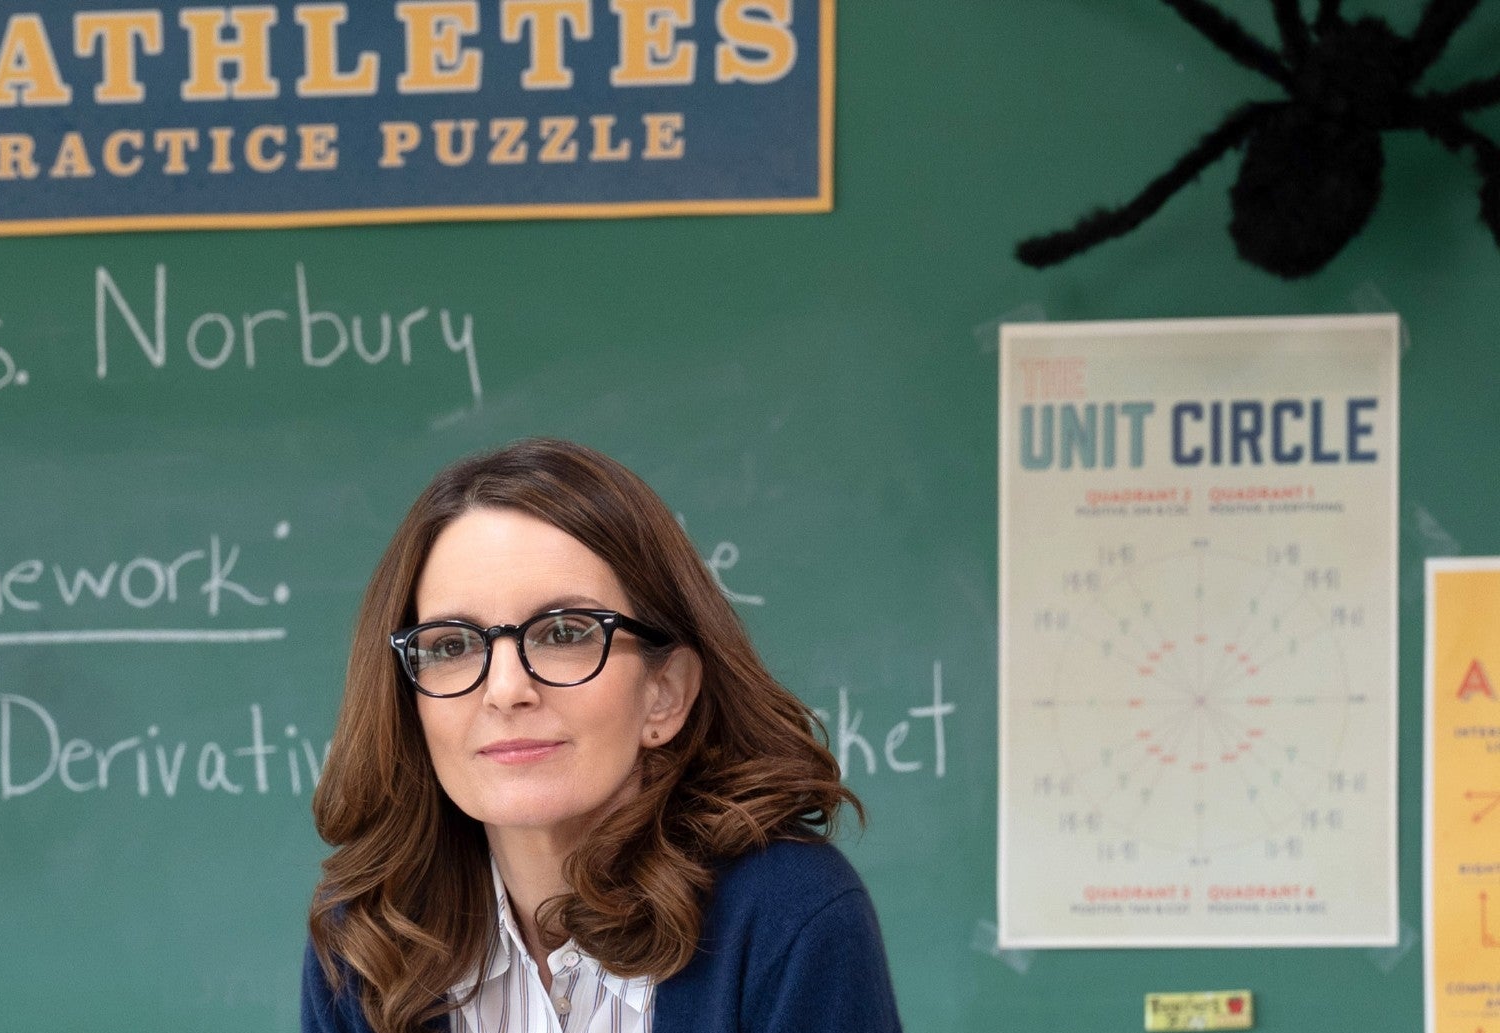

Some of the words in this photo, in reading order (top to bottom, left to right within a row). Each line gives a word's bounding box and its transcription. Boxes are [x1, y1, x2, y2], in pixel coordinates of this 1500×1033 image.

[379, 113, 687, 168] PUZZLE
[95, 263, 484, 405] Norbury
[1018, 358, 1086, 400] THE
[1019, 402, 1156, 471] UNIT
[1171, 398, 1379, 468] CIRCLE
